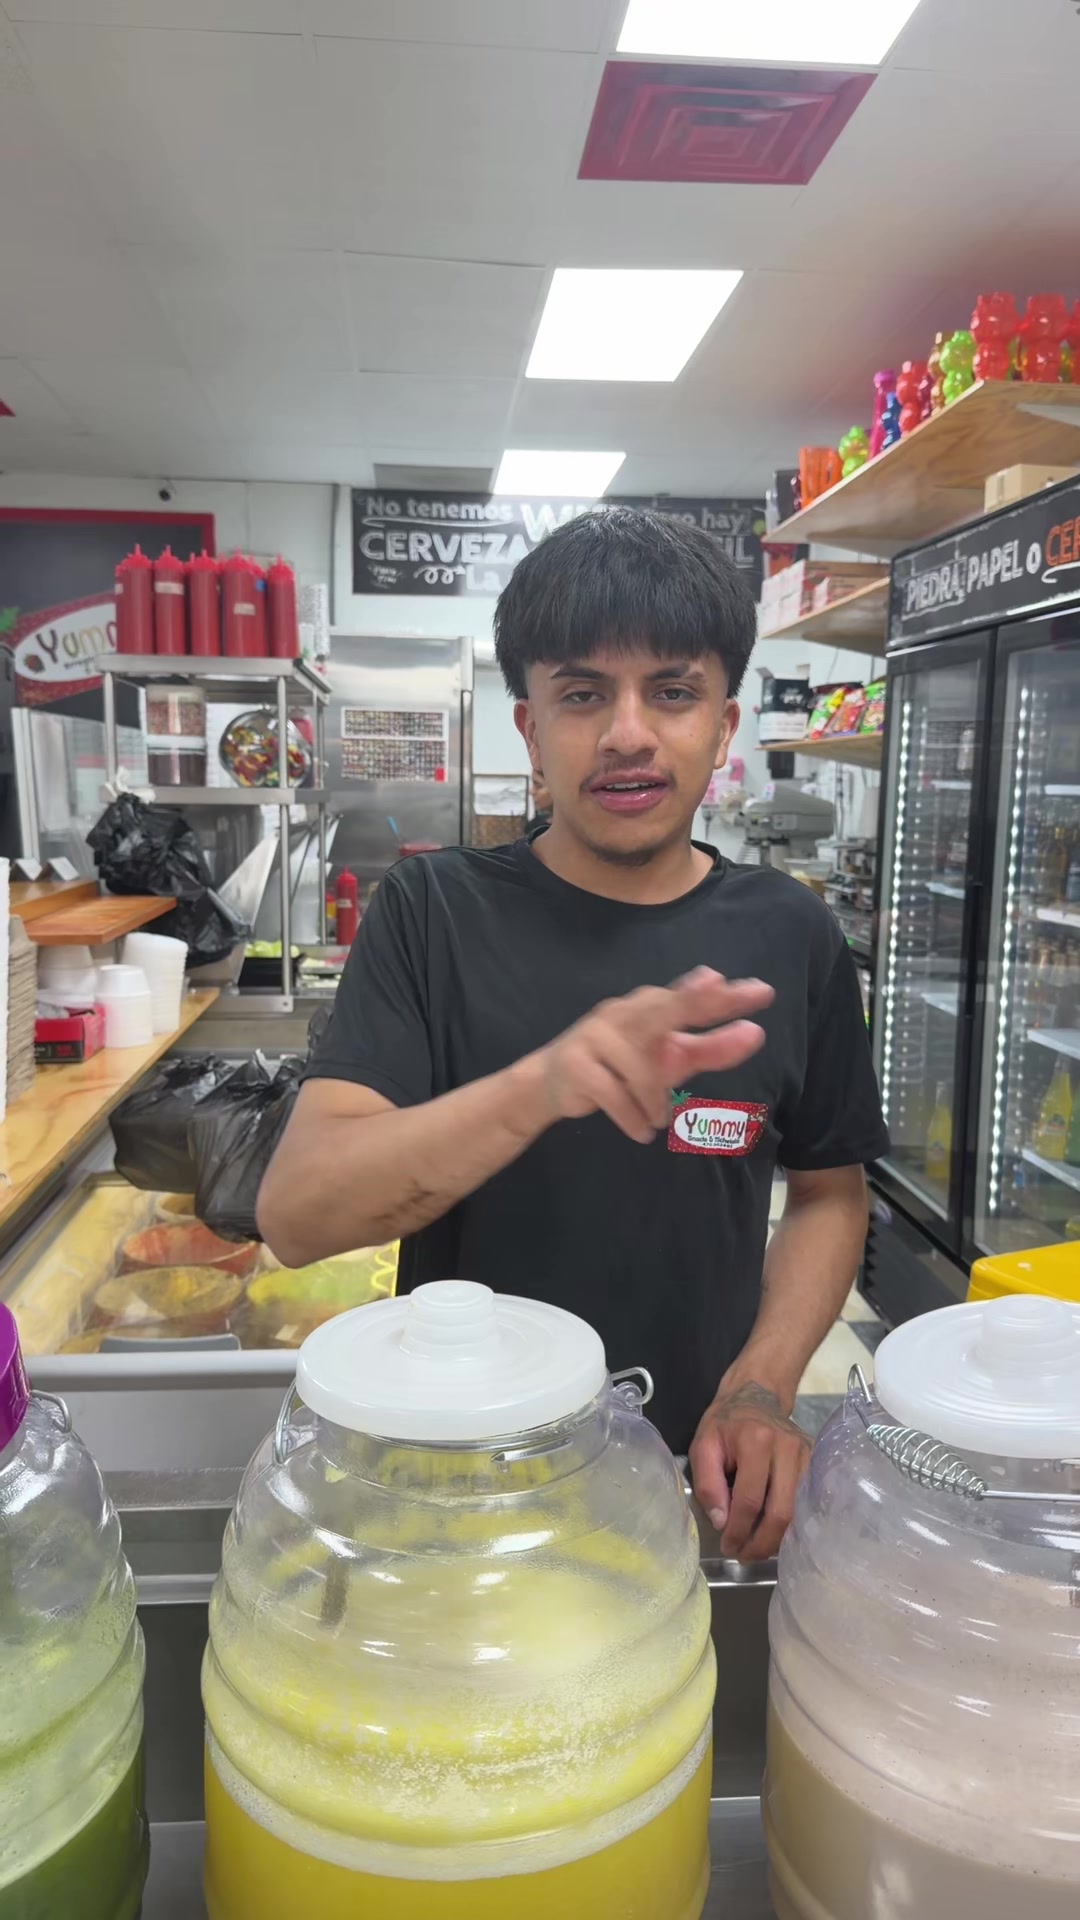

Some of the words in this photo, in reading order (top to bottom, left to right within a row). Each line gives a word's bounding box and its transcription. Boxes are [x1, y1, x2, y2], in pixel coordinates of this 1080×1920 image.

[367, 496, 401, 516] No
[406, 498, 514, 520] tenemos
[702, 507, 744, 535] hay
[967, 539, 1023, 593] PAPEL
